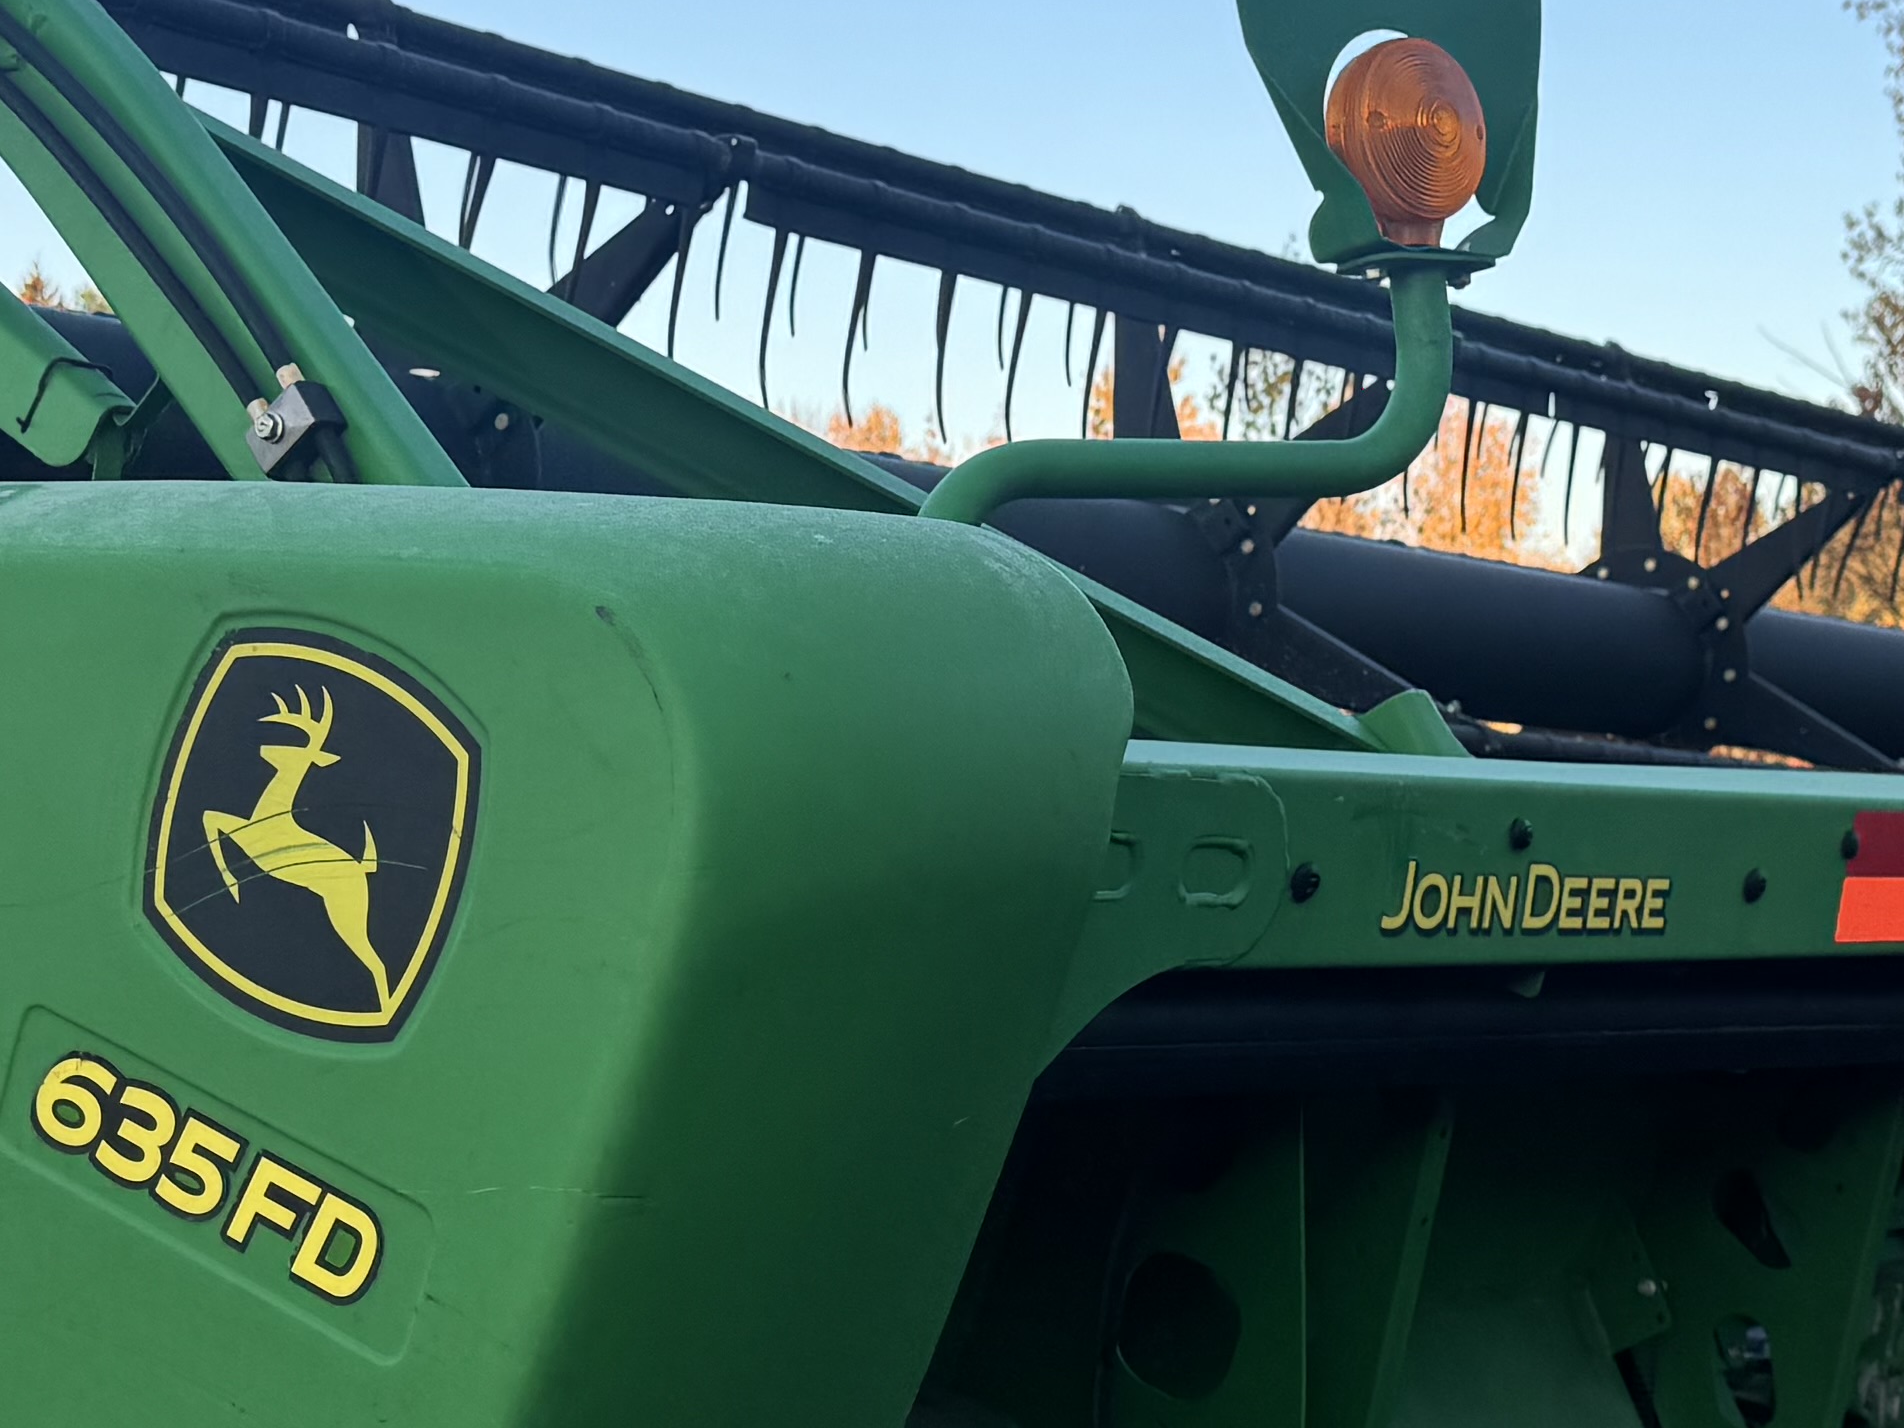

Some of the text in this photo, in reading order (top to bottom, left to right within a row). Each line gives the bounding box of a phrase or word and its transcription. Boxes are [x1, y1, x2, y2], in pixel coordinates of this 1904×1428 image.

[1380, 860, 1671, 930] JOHN DEERE
[33, 1055, 382, 1301] 635FD
